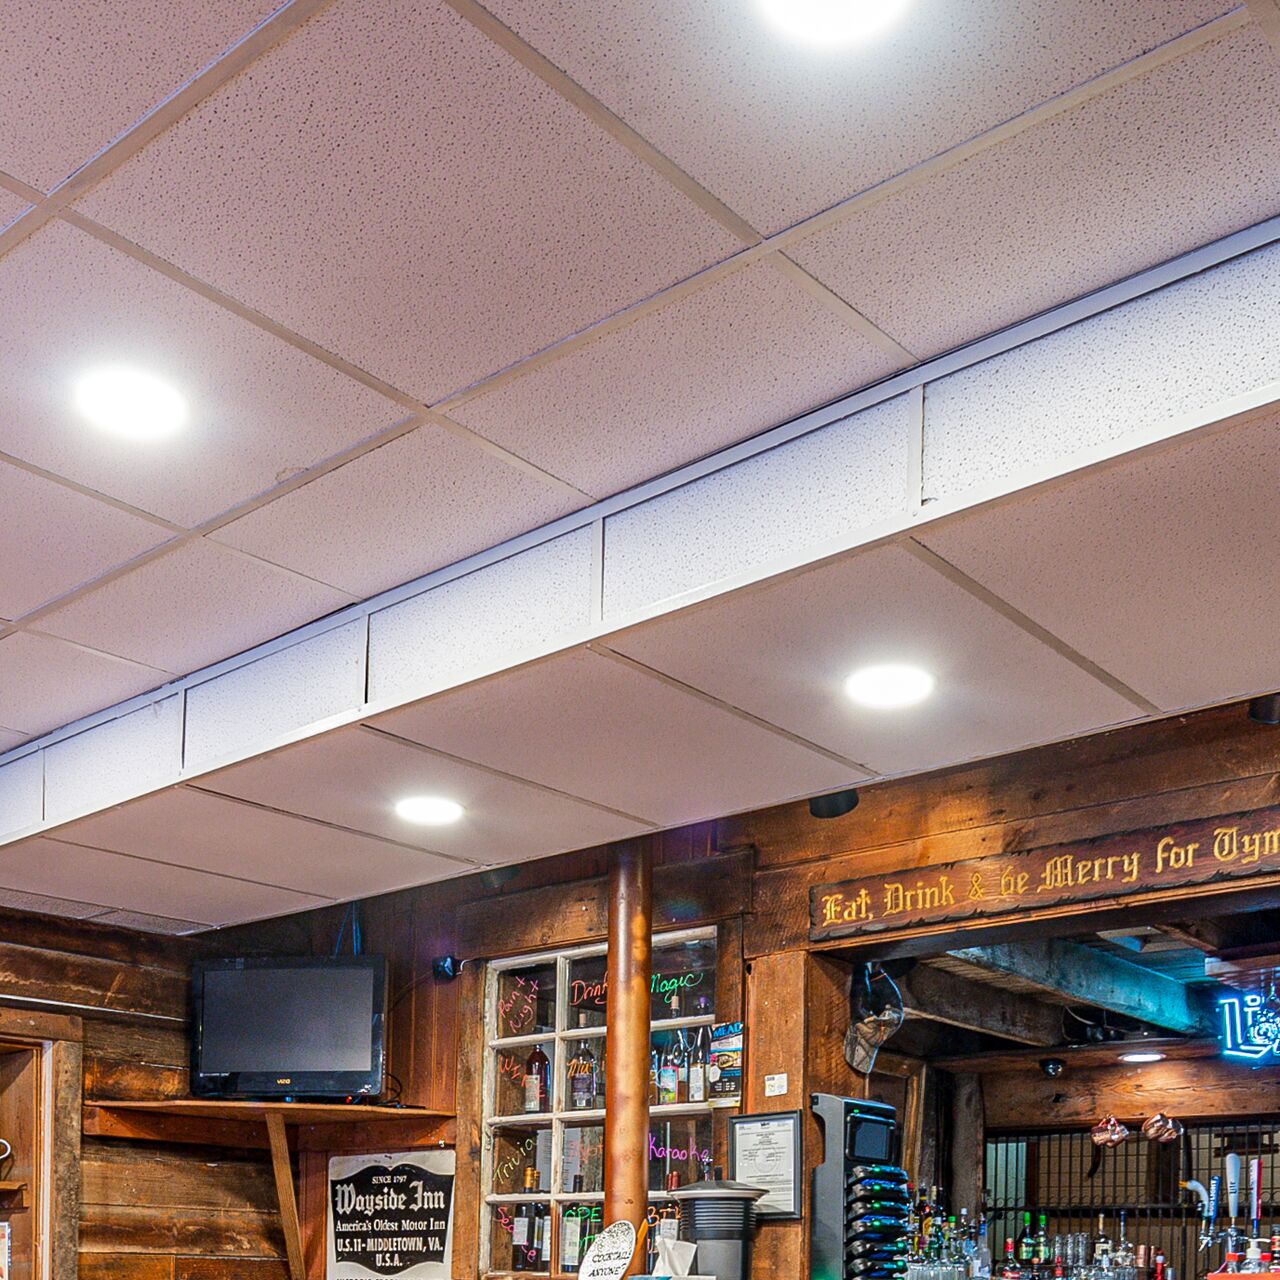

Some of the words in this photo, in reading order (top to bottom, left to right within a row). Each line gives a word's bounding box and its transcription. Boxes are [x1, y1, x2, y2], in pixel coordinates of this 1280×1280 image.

[821, 888, 874, 927] Eat,
[882, 876, 955, 917] Drink
[969, 873, 985, 901] &
[1000, 866, 1029, 896] be
[1036, 852, 1141, 893] Merry
[1155, 836, 1199, 874] for
[335, 1182, 407, 1217] Wayside
[409, 1181, 445, 1211] Inn
[335, 1220, 372, 1232] America's
[373, 1219, 399, 1231] Oldest
[401, 1219, 428, 1231] Motor
[429, 1217, 446, 1231] Inn
[428, 1236, 444, 1252] VA.
[375, 1253, 403, 1267] U.S.A.
